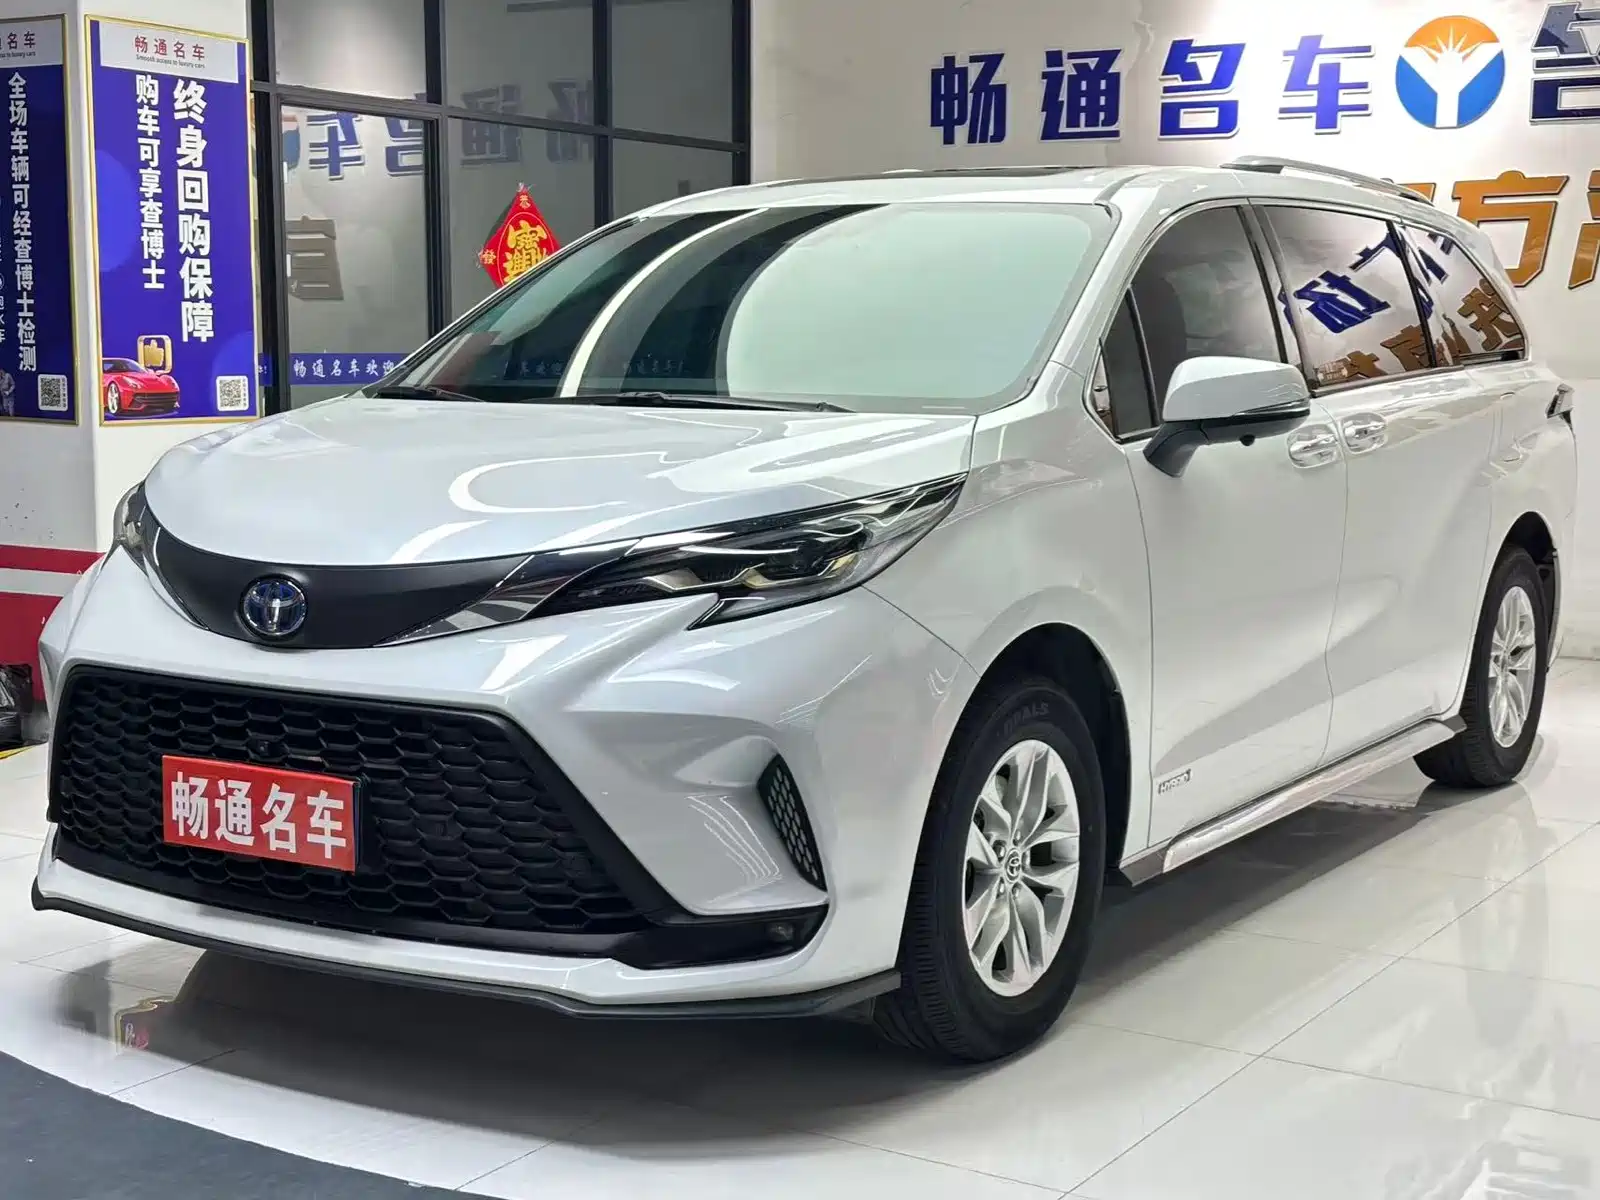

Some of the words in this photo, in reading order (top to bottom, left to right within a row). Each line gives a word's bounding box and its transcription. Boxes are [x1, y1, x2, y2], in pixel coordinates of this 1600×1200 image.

[0, 30, 36, 50] 名车
[134, 34, 206, 60] 畅通名车
[929, 34, 1374, 146] 畅通名车
[8, 71, 37, 372] 全场车辆可经查博士检测
[135, 74, 165, 290] 购车可享查博士
[173, 78, 215, 343] 终身回购保障
[171, 771, 347, 860] 畅通名车
